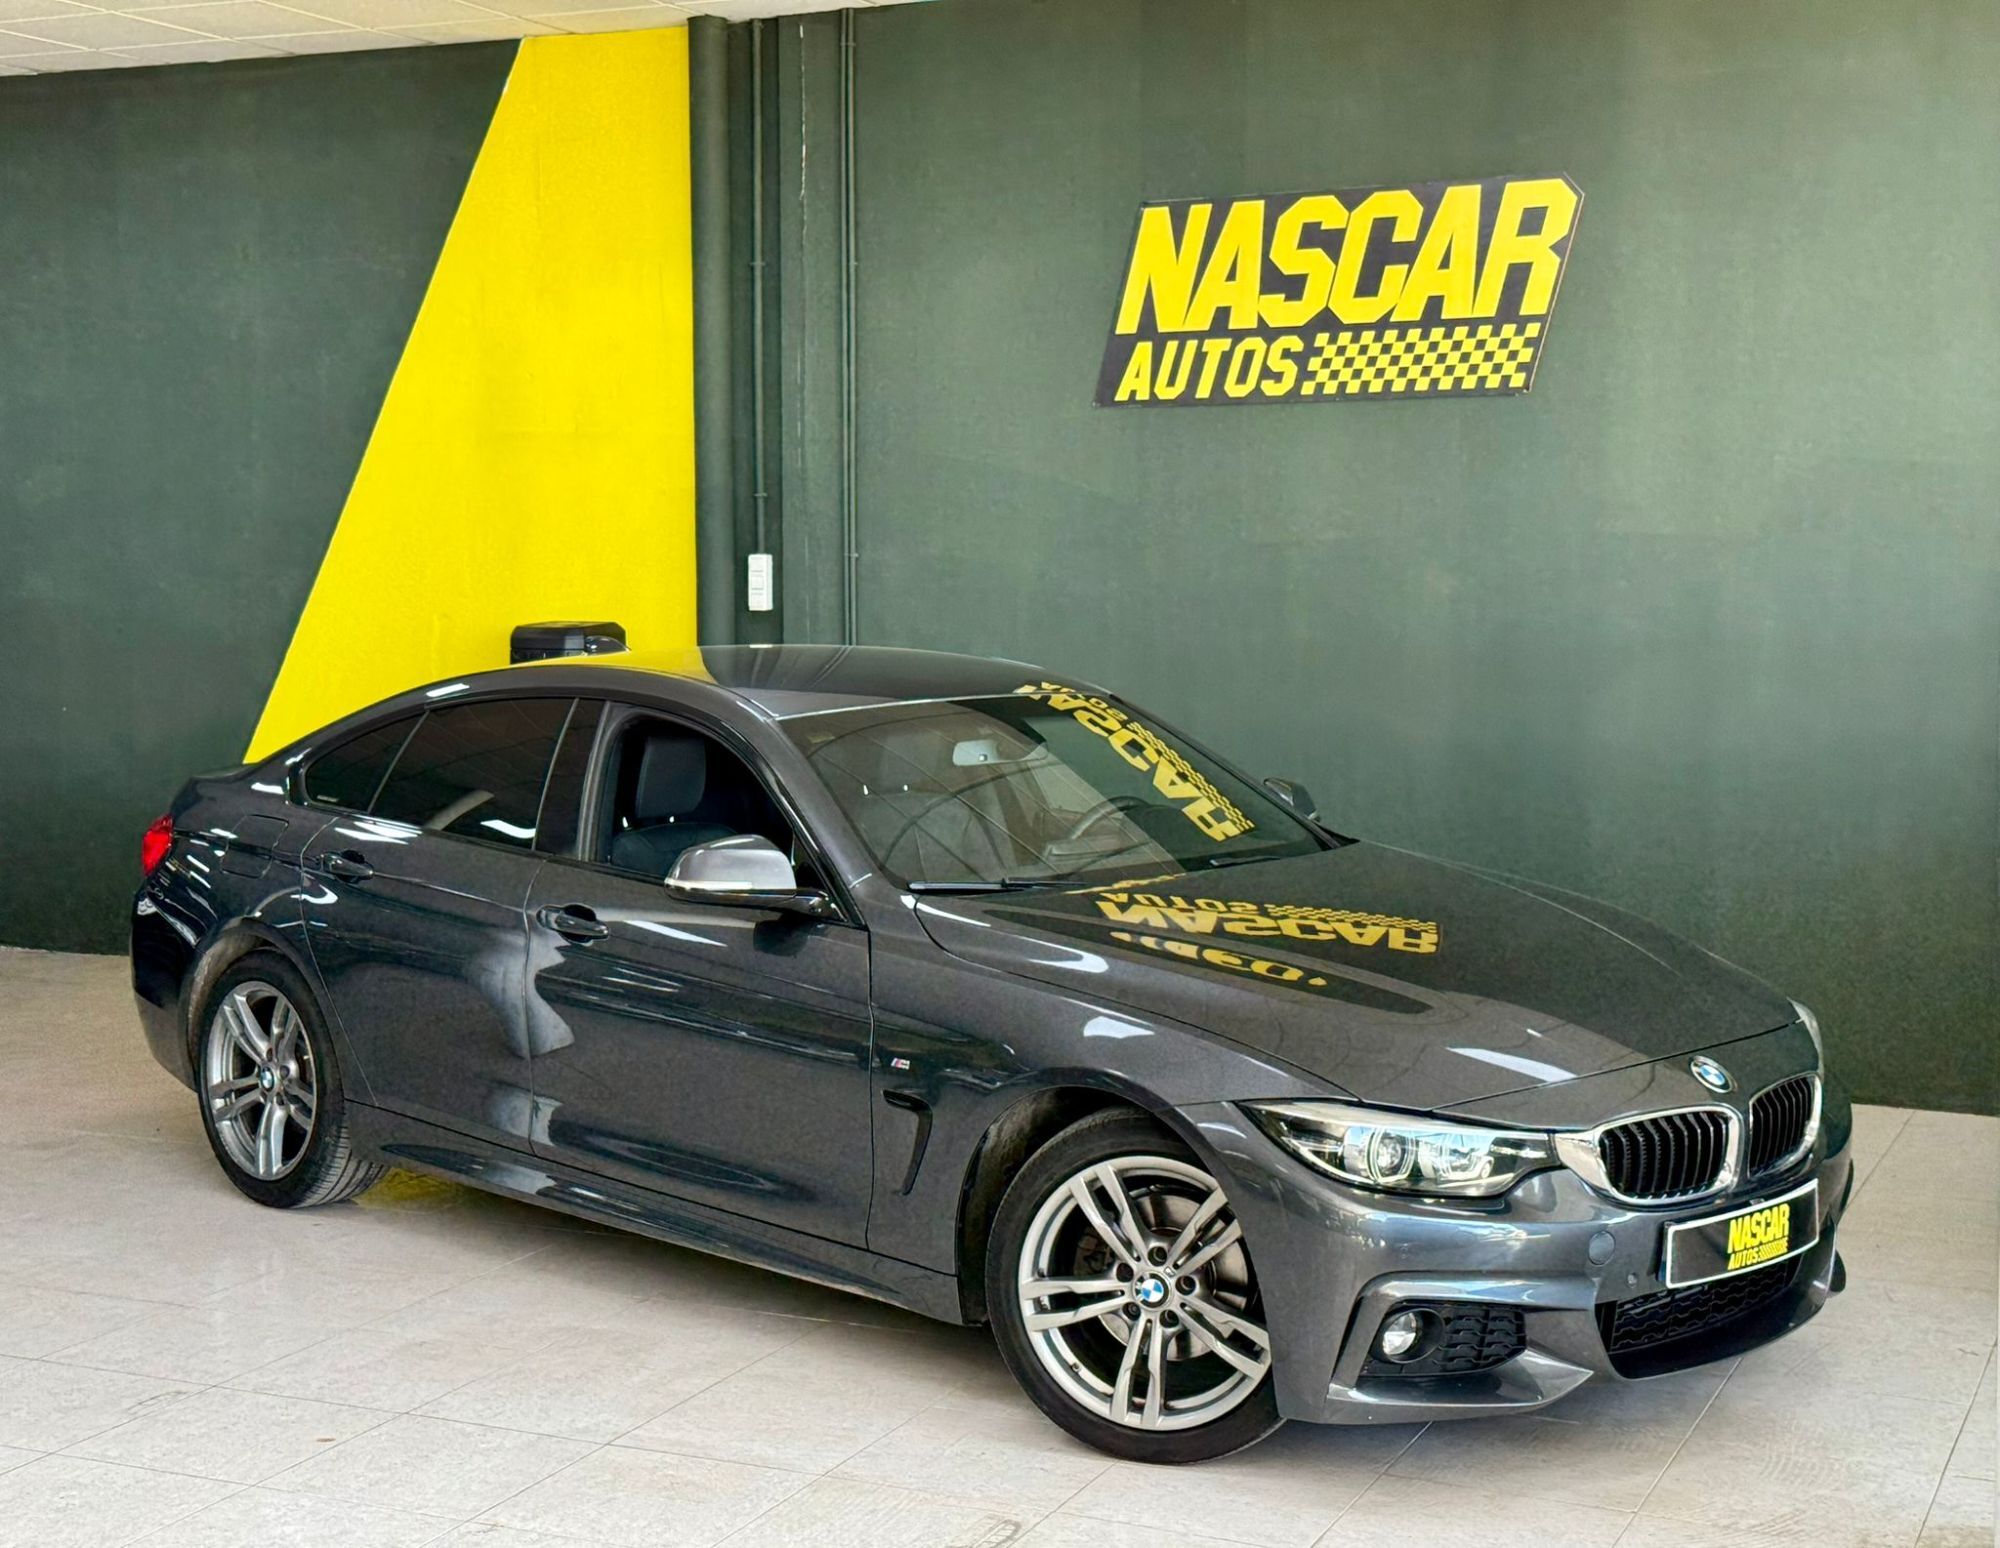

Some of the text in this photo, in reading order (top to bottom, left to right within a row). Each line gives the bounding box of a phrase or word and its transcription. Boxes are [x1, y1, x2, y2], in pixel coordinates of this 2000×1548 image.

[1115, 178, 1577, 334] NASCAR
[1114, 335, 1304, 401] AUTOS
[1727, 1203, 1790, 1254] NASCAR
[1727, 1247, 1759, 1271] AUTOS
